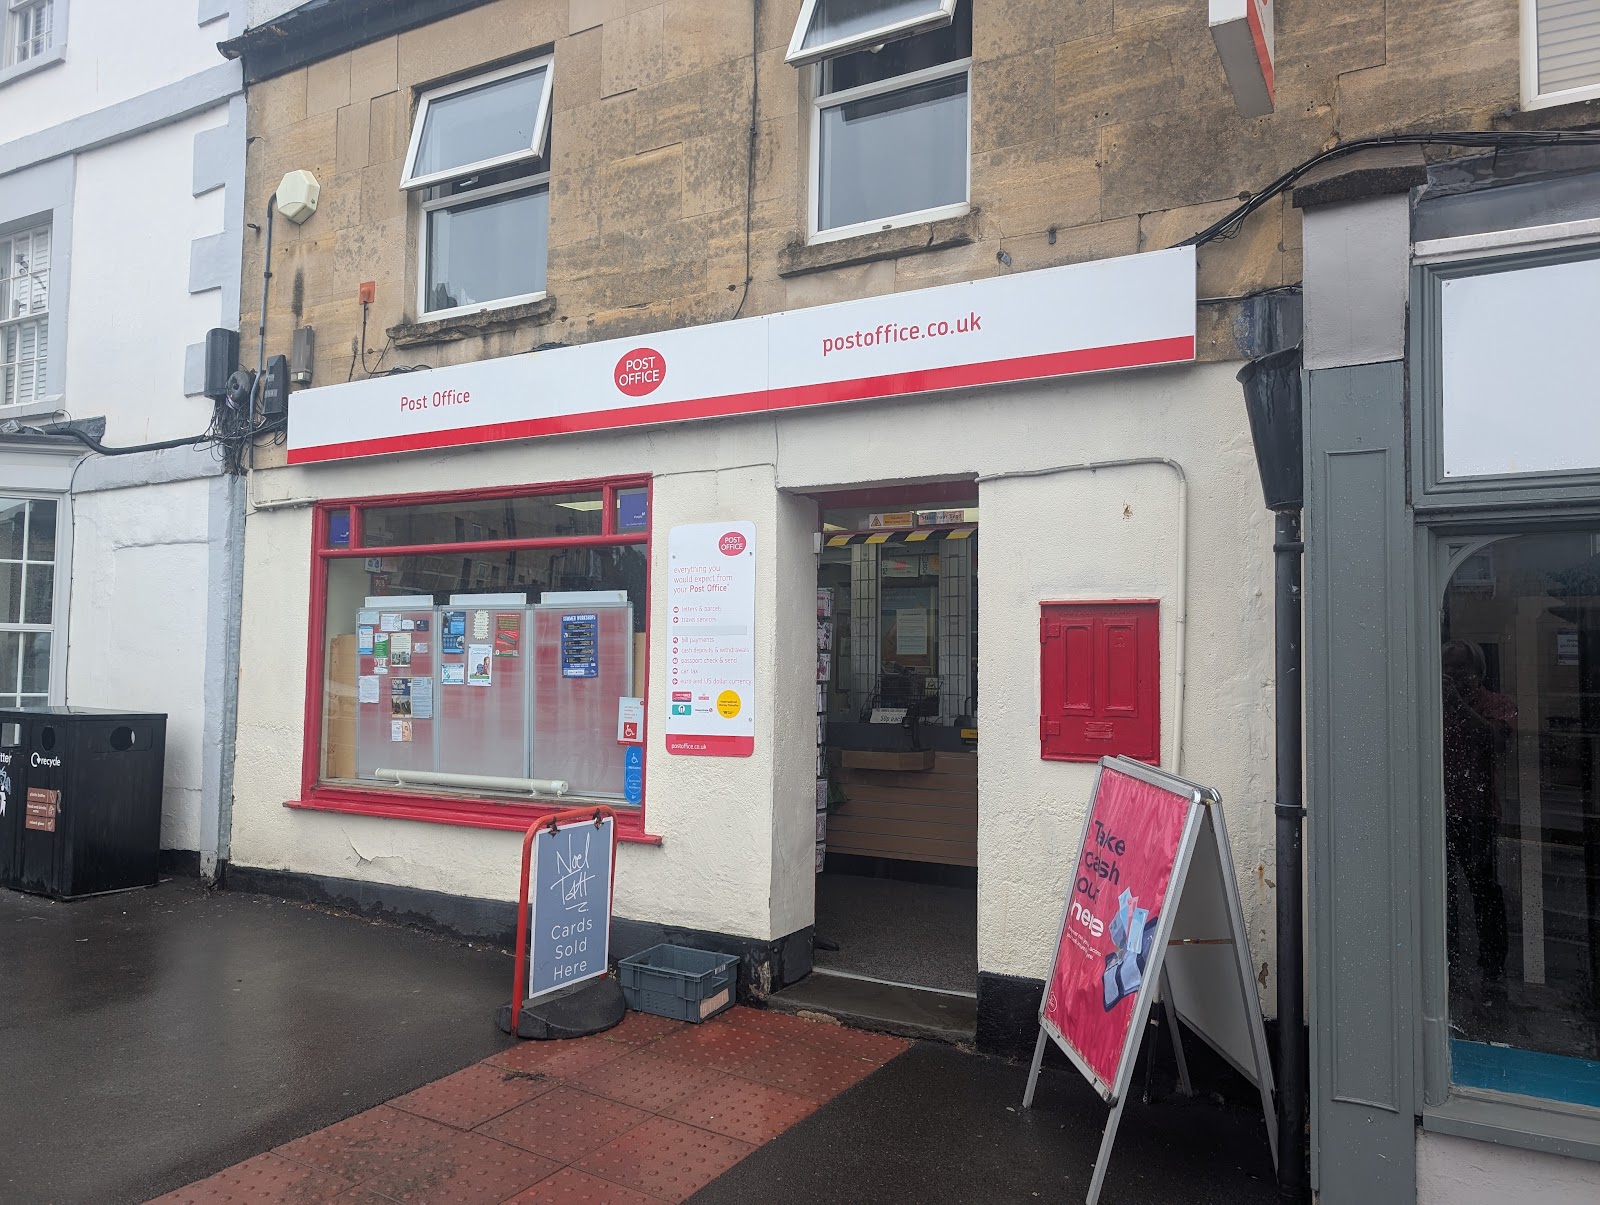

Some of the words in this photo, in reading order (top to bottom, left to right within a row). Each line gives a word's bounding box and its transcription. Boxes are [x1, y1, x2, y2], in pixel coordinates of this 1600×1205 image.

[823, 312, 982, 357] postoffice.co.uk
[626, 356, 656, 372] POST
[619, 369, 660, 386] OFFICE
[400, 395, 428, 412] Post
[432, 389, 470, 408] Office
[720, 542, 743, 551] OFFICE
[724, 536, 741, 544] POST
[673, 566, 707, 574] everything
[708, 565, 721, 573] you
[673, 575, 693, 583] would
[694, 575, 715, 584] expect
[716, 574, 733, 582] from
[673, 586, 688, 594] your
[704, 605, 722, 613] parcels
[671, 742, 707, 750] postoffice.co.uk
[0, 752, 12, 763] tter
[41, 756, 61, 768] recycle
[1094, 820, 1126, 857] Take
[556, 832, 590, 874] Noel
[1084, 851, 1120, 886] cash
[551, 917, 593, 940] Cards
[555, 937, 587, 960] Sold
[553, 960, 588, 981] Here
